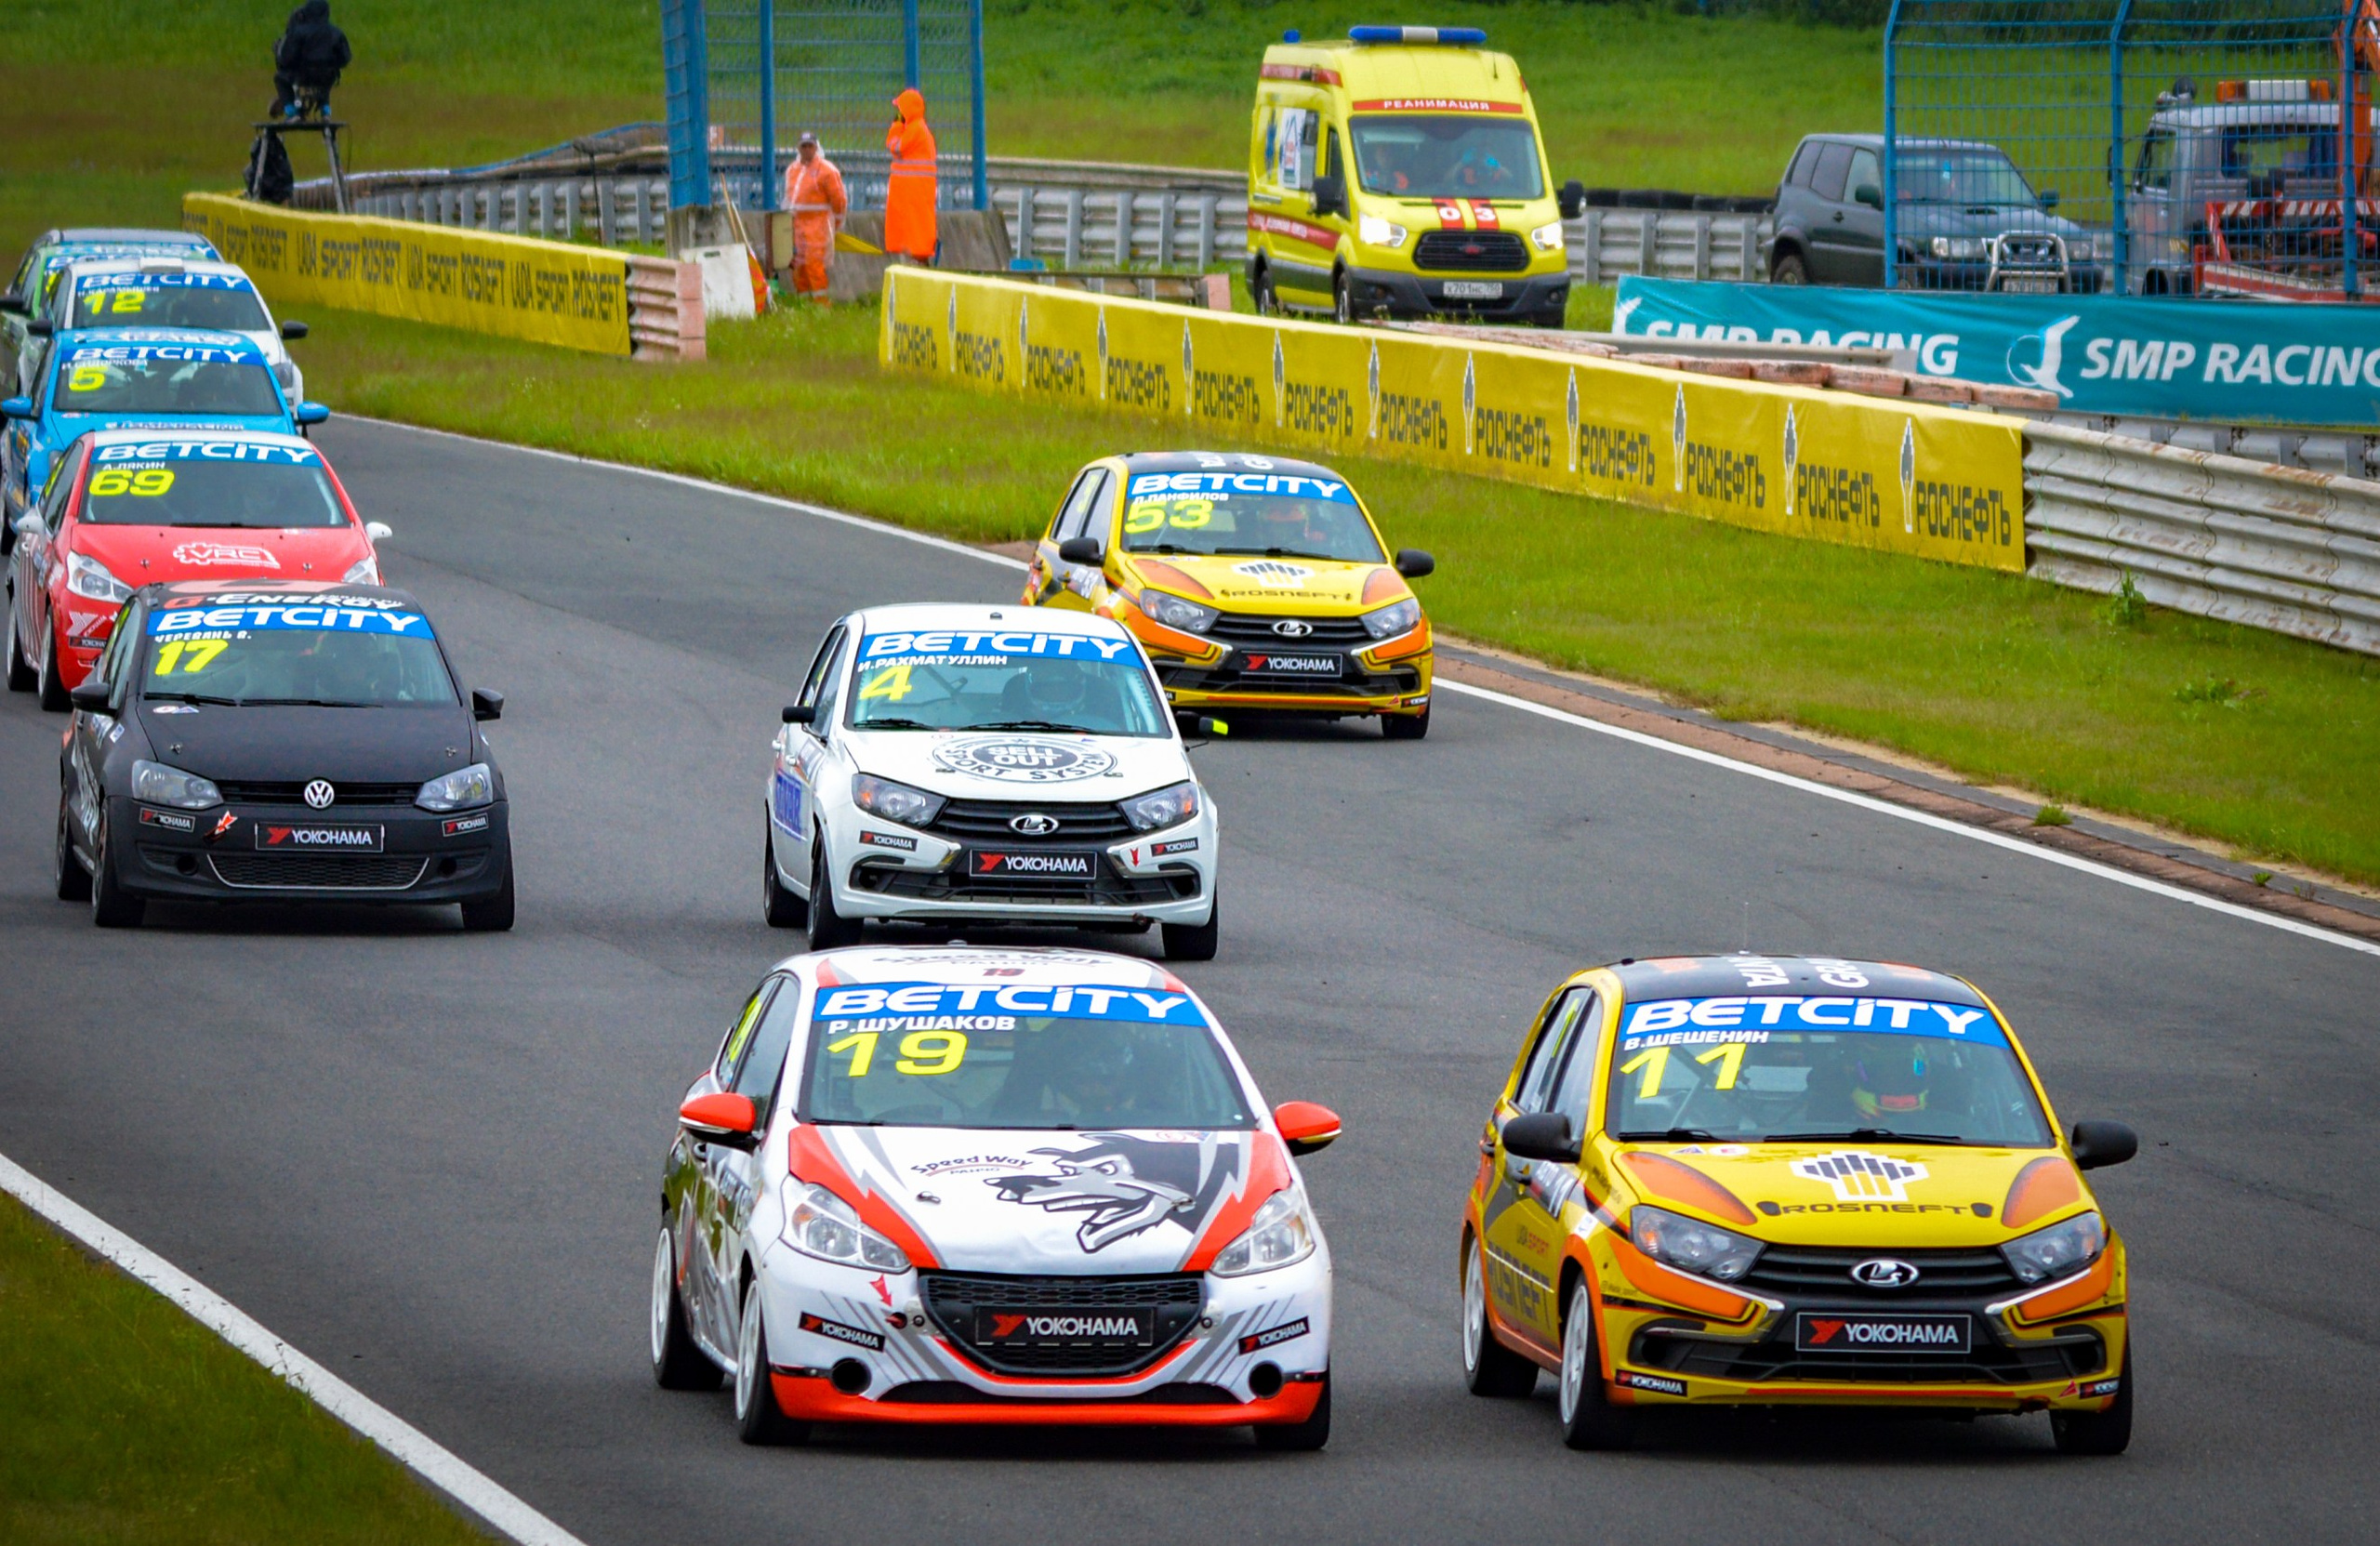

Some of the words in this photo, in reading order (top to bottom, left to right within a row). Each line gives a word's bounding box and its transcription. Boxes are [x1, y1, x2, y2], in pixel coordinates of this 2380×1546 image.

[1383, 99, 1489, 111] РЕАНИМАЦИЯ
[83, 273, 244, 288] BETCITY
[84, 291, 146, 314] 12
[73, 347, 248, 363] BETCITY
[957, 332, 1004, 382] РОСНЕФТЬ
[2080, 338, 2196, 380] SMP
[69, 366, 108, 391] 5
[1027, 345, 1085, 396] РОСНЕФТЬ
[1106, 356, 1170, 410] РОСНЕФТЬ
[1194, 370, 1260, 424] РОСНЕФТЬ
[1286, 382, 1353, 437] РОСНЕФТЬ
[1381, 392, 1448, 450] РОСНЕФТЬ
[1474, 406, 1551, 469] РОСНЕФТЬ
[98, 442, 316, 463] BETCITY
[1580, 423, 1655, 486] РОСНЕФТЬ
[89, 469, 175, 496] 69
[1131, 472, 1342, 498] BETCITY
[1687, 442, 1765, 509] РОСНЕФТЬ
[1797, 463, 1880, 528] РОСНЕФТЬ
[1124, 499, 1214, 535] 53
[1915, 480, 2012, 547] РОСНЕФТЬ
[156, 607, 420, 632] BETCITY
[154, 639, 229, 676] 17
[866, 632, 1129, 659] BETCITY
[857, 655, 1008, 672] И.РАХМАТУЛЛИН
[1267, 657, 1335, 671] YOKOHAMA
[859, 665, 912, 701] 4
[945, 749, 1012, 776] SPORT
[994, 755, 1059, 766] OUT
[292, 829, 372, 845] YOKOHAMA
[873, 835, 913, 850] YOKOHAMA
[1165, 840, 1197, 852] YOKOHAMA
[1004, 855, 1088, 872] YOKOHAMA
[982, 968, 1025, 977] 19
[820, 985, 1188, 1019] BETCITY
[827, 1015, 1015, 1035] Р.ШУШАКОВ
[1625, 997, 1986, 1034] BETCITY
[1624, 1030, 1769, 1050] В.ШЕШЕНИН
[827, 1030, 969, 1077] 19
[1620, 1043, 1747, 1099] 11
[910, 1155, 980, 1174] Speed
[985, 1155, 1033, 1168] Way
[1778, 1203, 1968, 1216] ROSNEFT
[822, 1321, 879, 1348] YOKOHAMA
[1026, 1316, 1139, 1336] YOKOHAMA
[1258, 1322, 1306, 1345] YOKOHAMA
[1845, 1323, 1959, 1344] YOKOHAMA
[1631, 1374, 1683, 1394] YOKOHAMA
